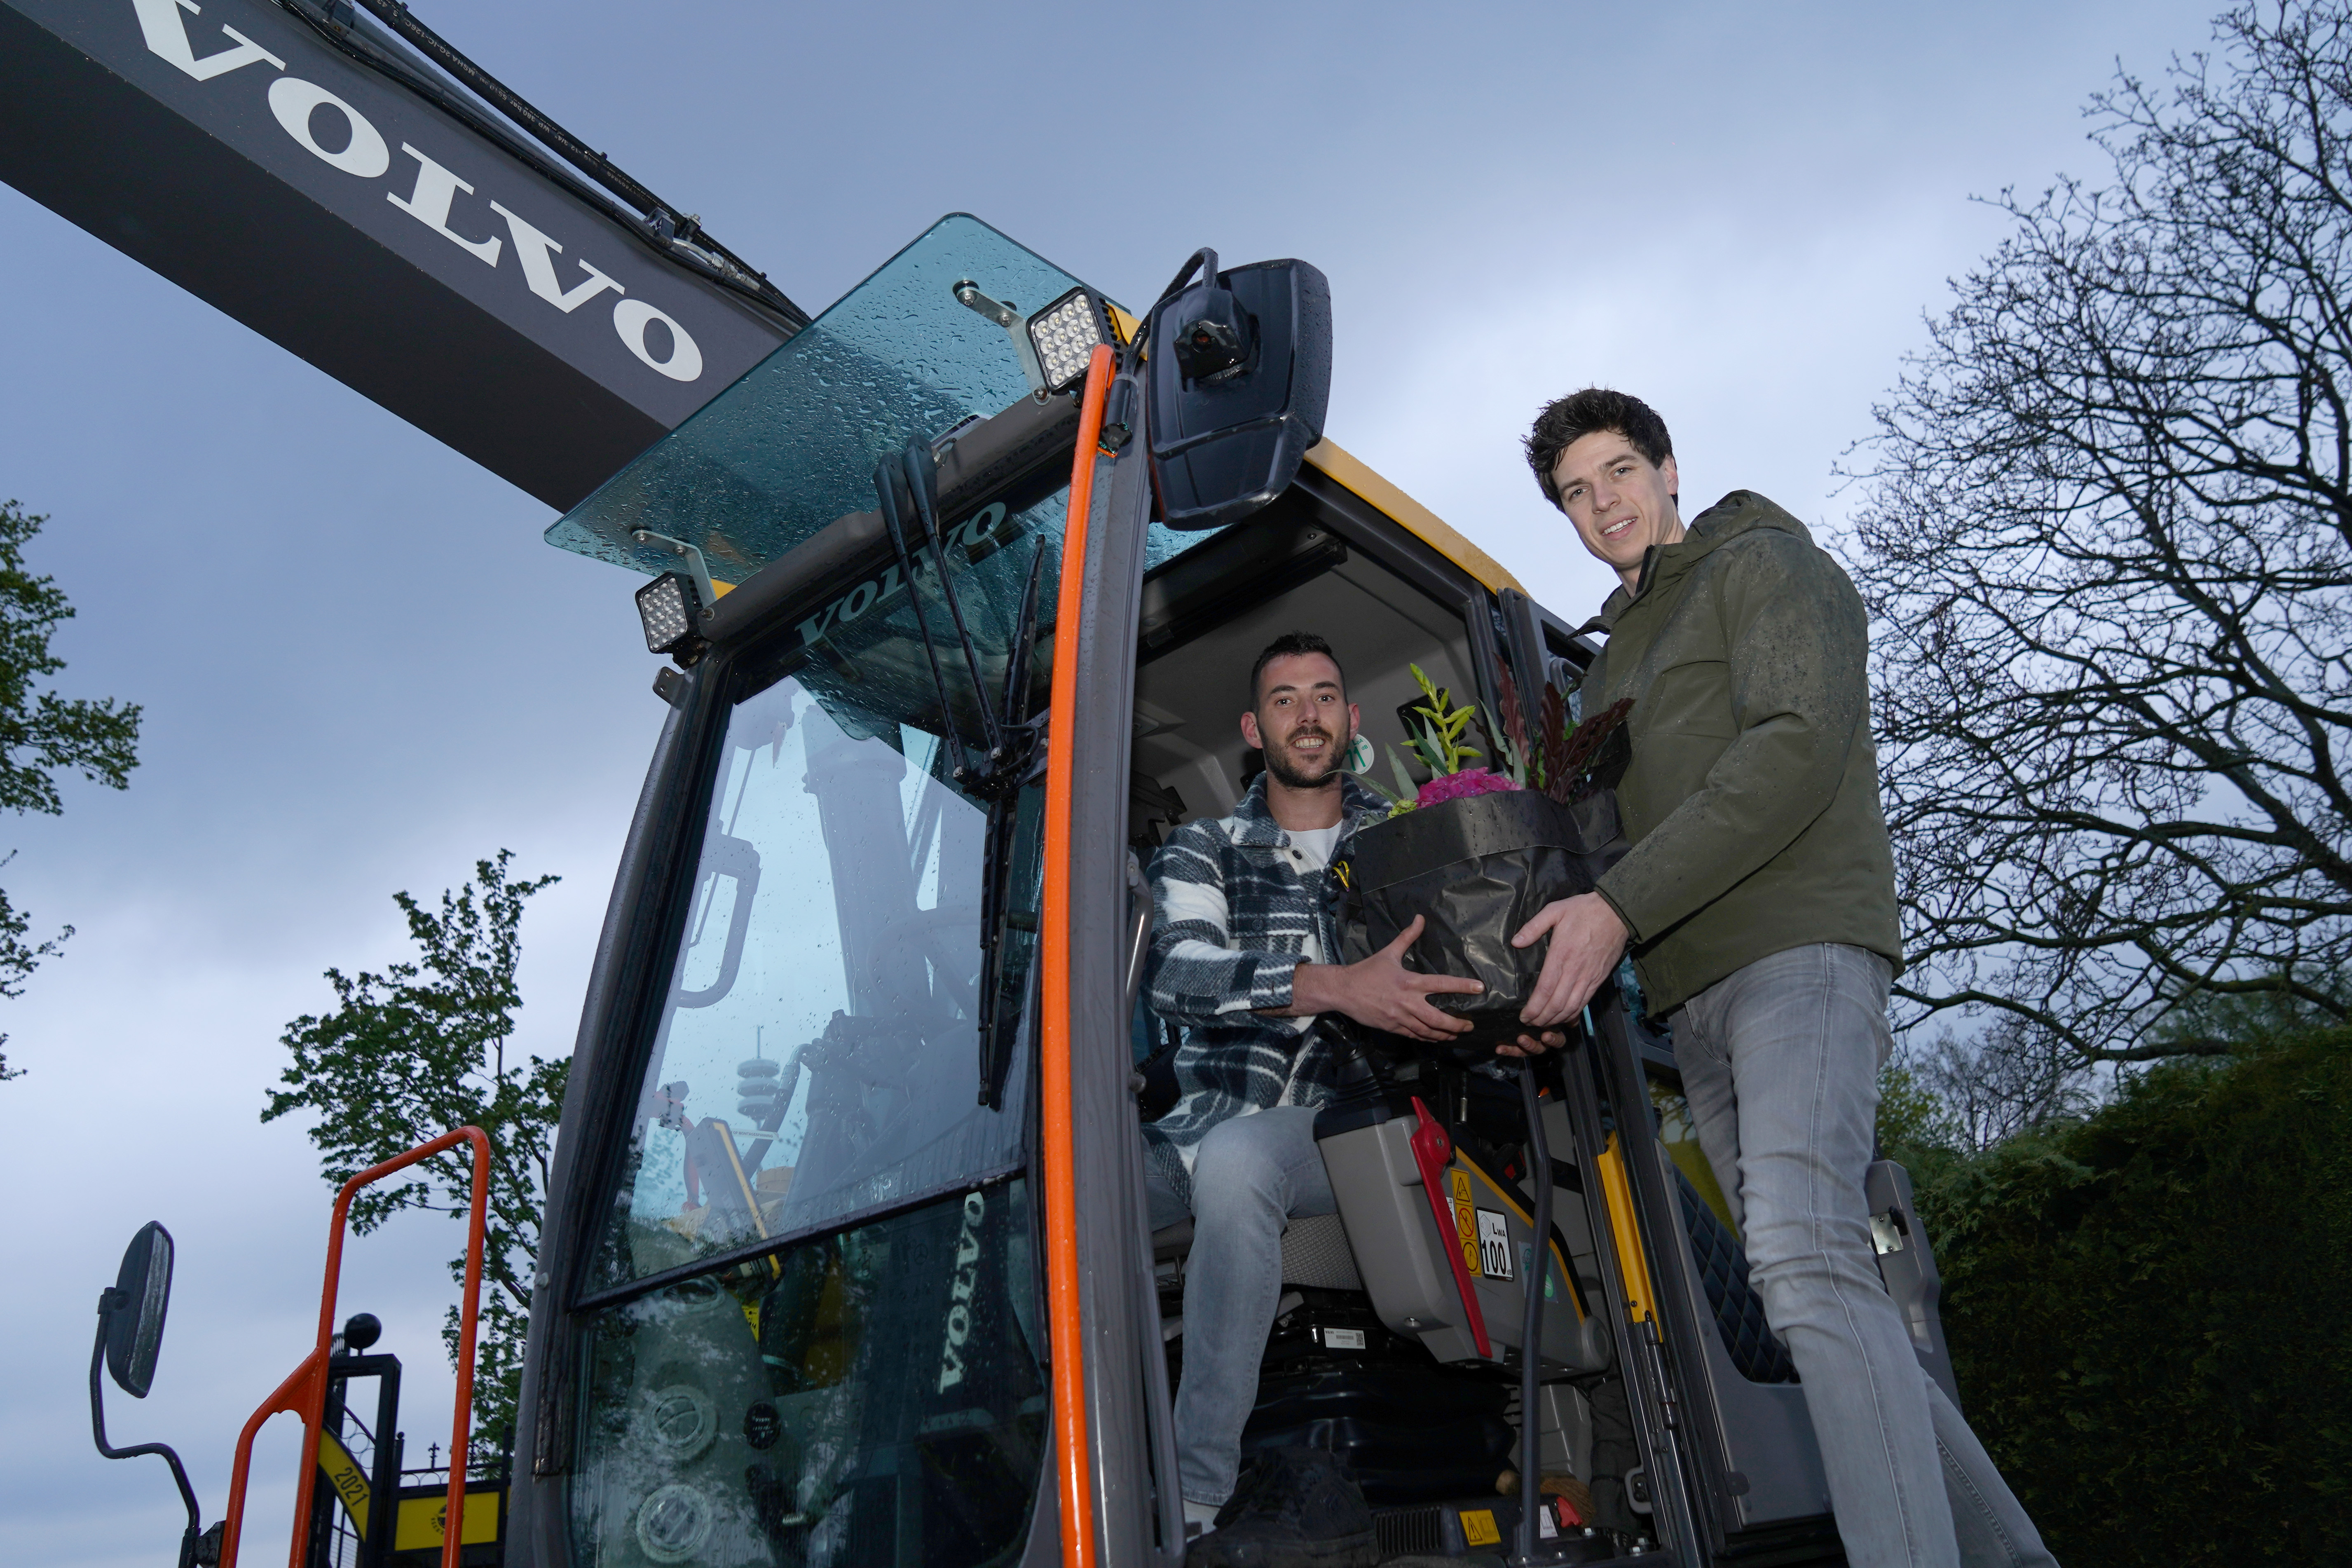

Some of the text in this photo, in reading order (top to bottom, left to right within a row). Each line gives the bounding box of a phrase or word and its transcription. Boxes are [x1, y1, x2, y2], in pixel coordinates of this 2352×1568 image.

[452, 55, 475, 76] MSHA
[510, 100, 522, 113] bar
[523, 110, 535, 122] 380
[538, 122, 550, 134] WP
[133, 0, 703, 382] VOLVO
[794, 502, 1006, 646] VOLVO
[1482, 1240, 1506, 1275] 100
[939, 1191, 984, 1395] VOLVO
[334, 1467, 369, 1506] 2021
